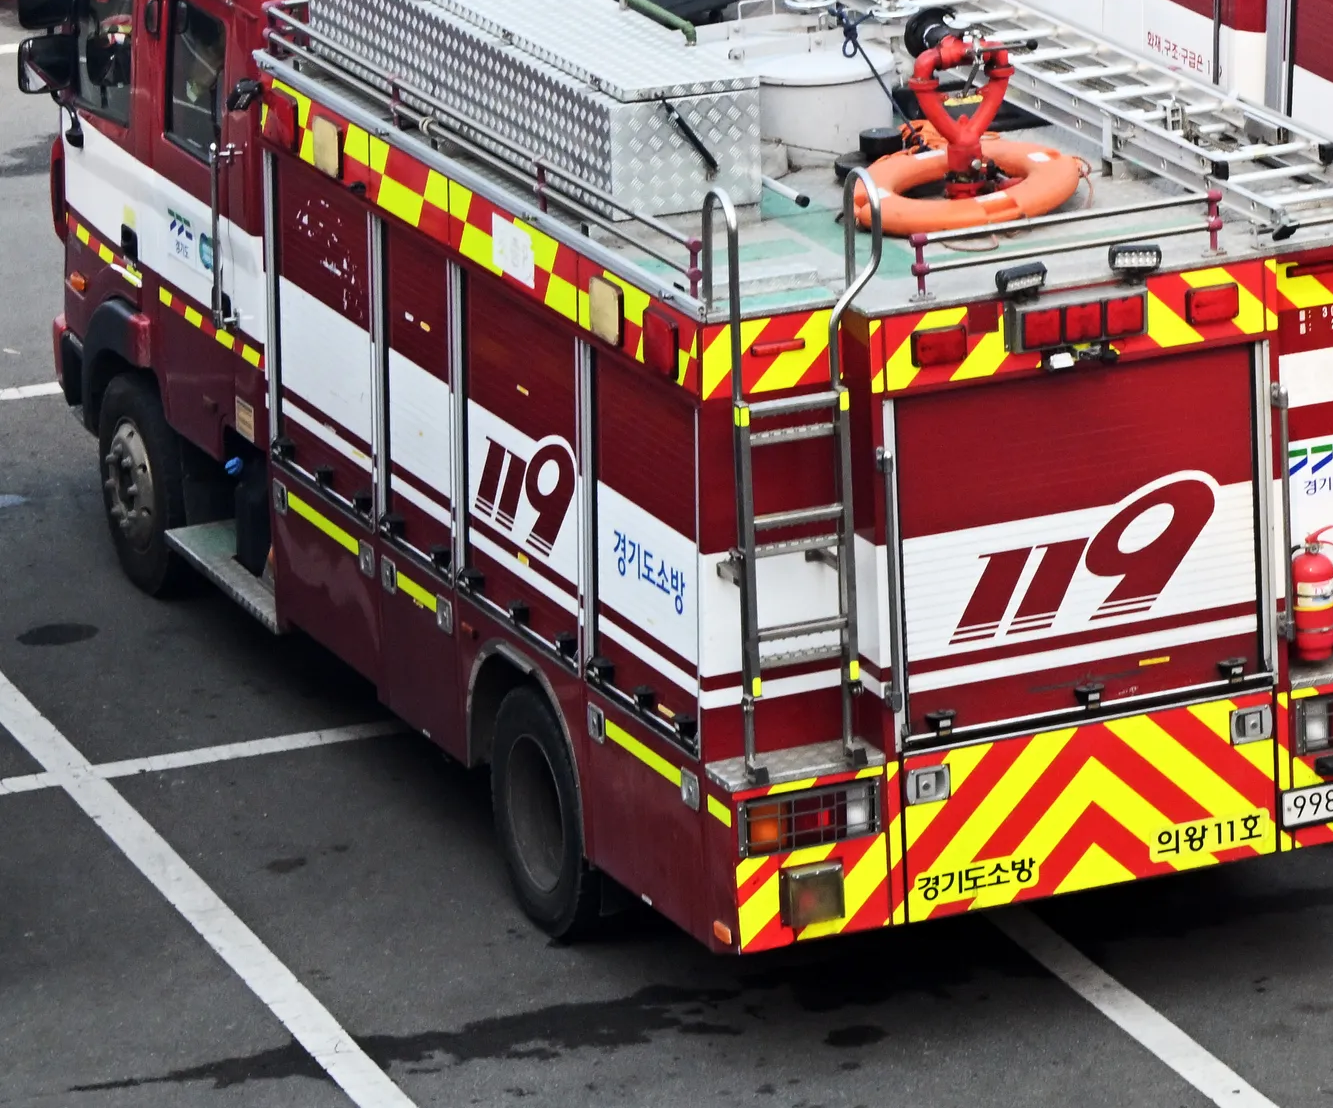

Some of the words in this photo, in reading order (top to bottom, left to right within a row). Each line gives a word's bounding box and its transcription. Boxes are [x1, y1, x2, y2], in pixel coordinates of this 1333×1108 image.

[474, 435, 576, 557] 119
[613, 529, 686, 615] 경기도소방
[948, 479, 1215, 645] 119
[1156, 827, 1209, 855] 의왕
[1213, 813, 1263, 845] 11호
[917, 857, 1037, 900] 경기도소방
